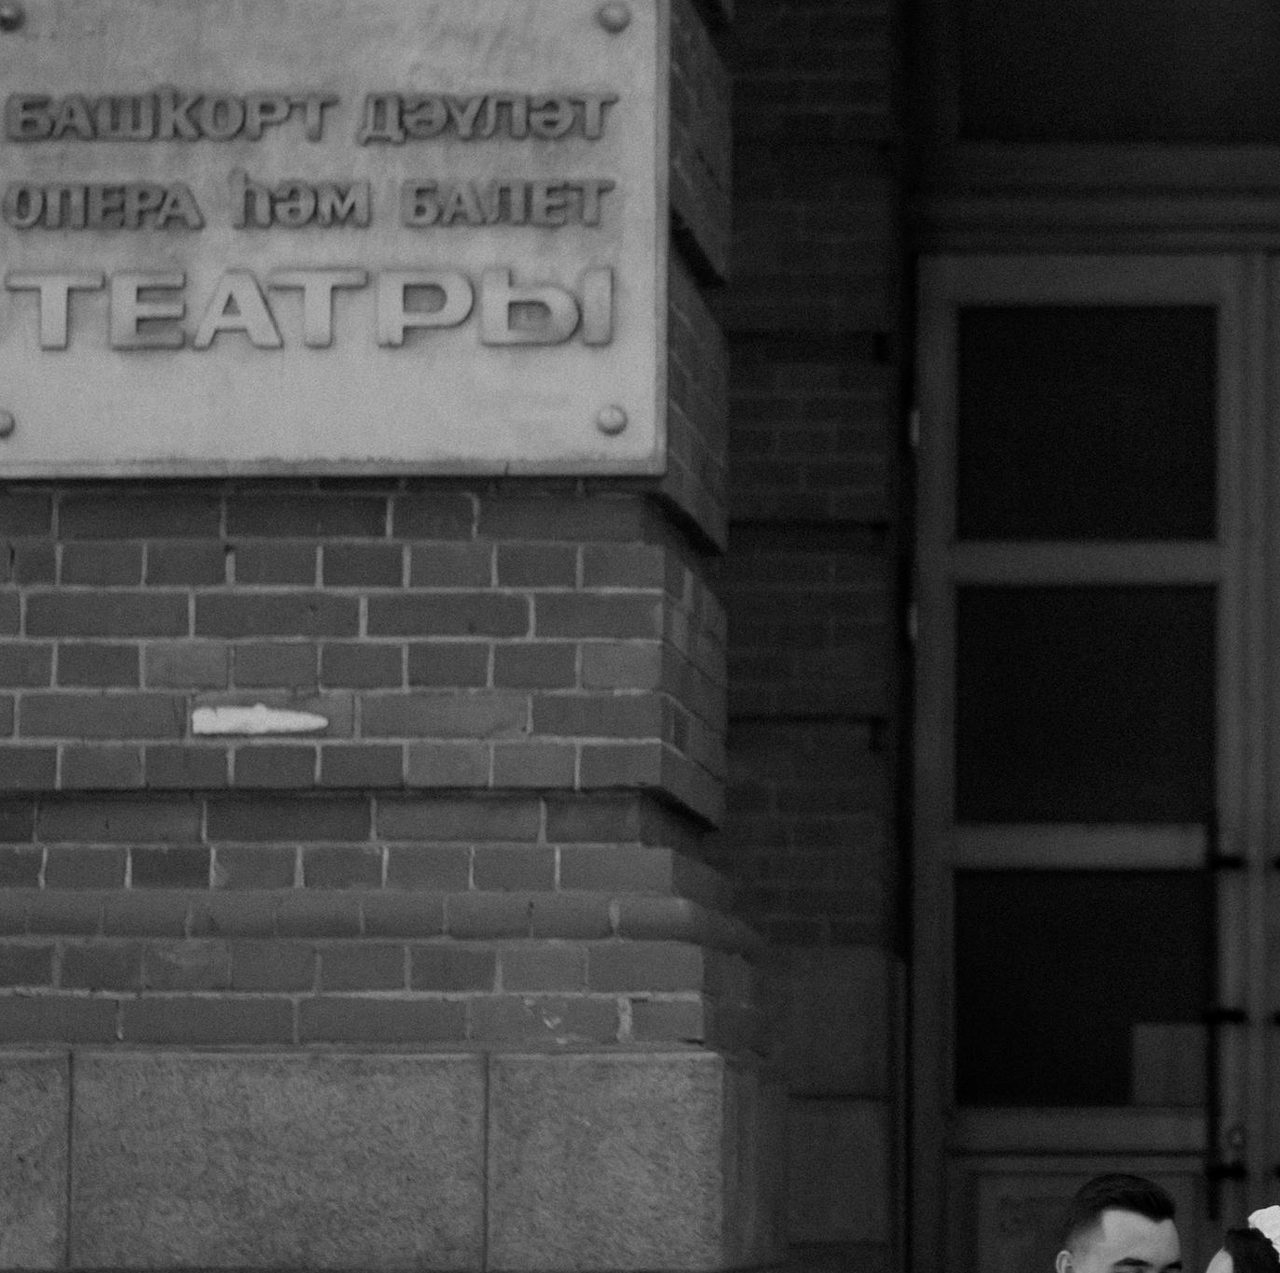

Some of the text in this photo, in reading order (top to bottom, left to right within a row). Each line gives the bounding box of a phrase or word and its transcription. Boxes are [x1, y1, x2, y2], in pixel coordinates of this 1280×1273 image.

[2, 180, 206, 229] ОПЕРА
[402, 179, 616, 228] БАЛЕТ
[4, 267, 614, 352] ТЕАТРЫ
